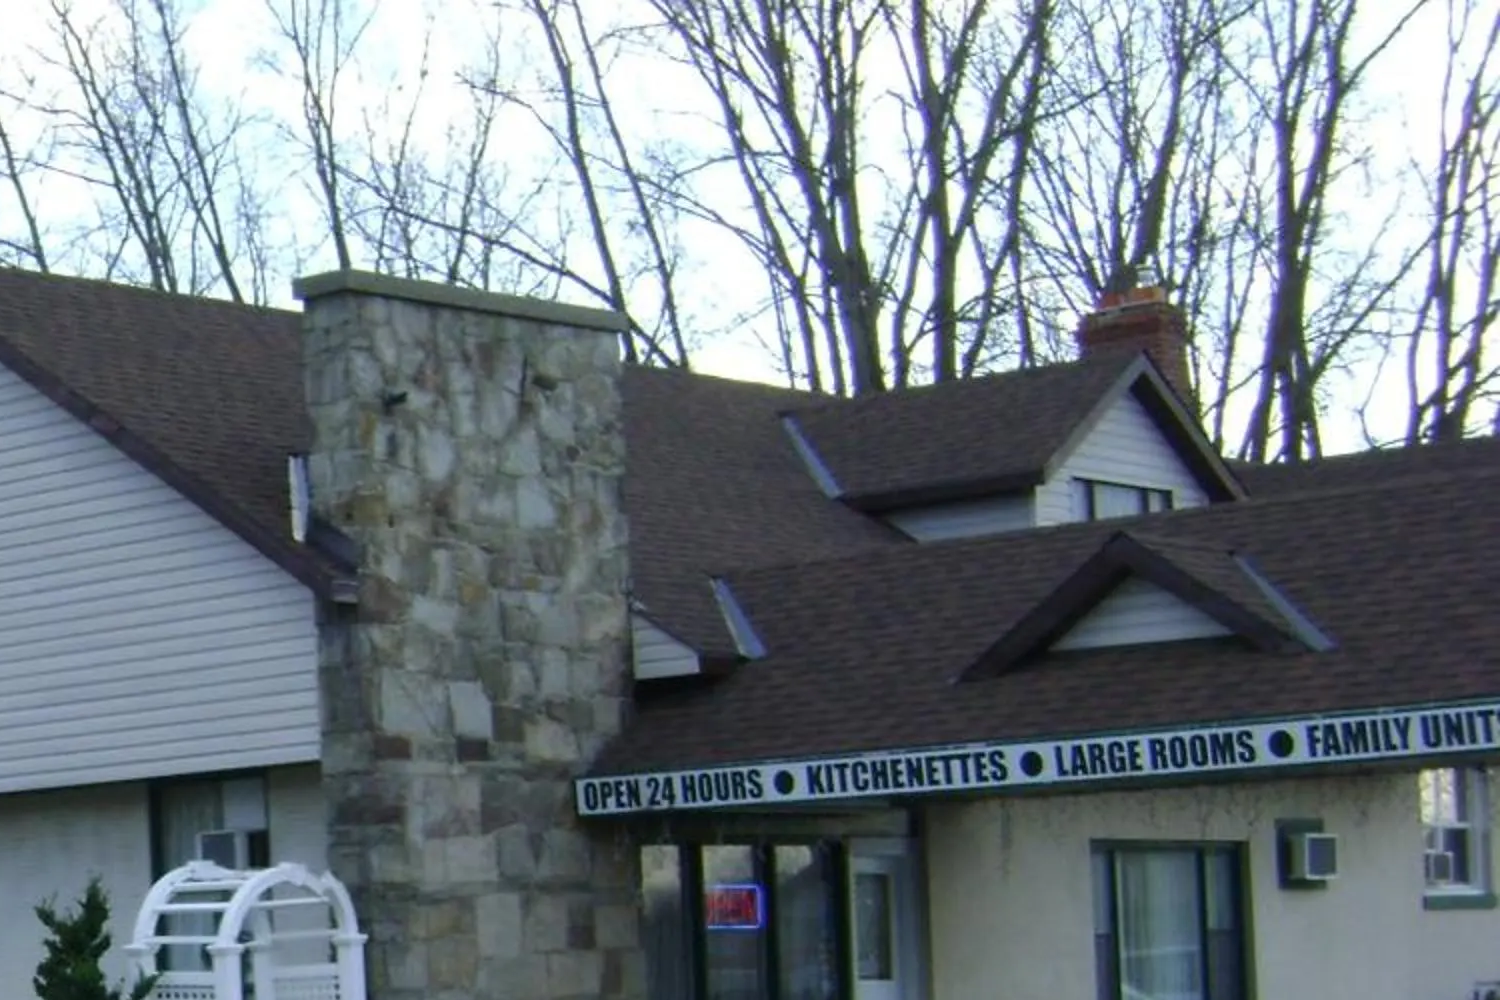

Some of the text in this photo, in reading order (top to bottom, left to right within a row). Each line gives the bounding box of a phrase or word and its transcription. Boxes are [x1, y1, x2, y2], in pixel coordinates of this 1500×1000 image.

[1054, 730, 1256, 777] LARGE ROOMS
[1306, 716, 1411, 758] FAMILY
[583, 769, 763, 811] OPEN 24 HOURS
[806, 750, 1008, 795] KITCHENETTES
